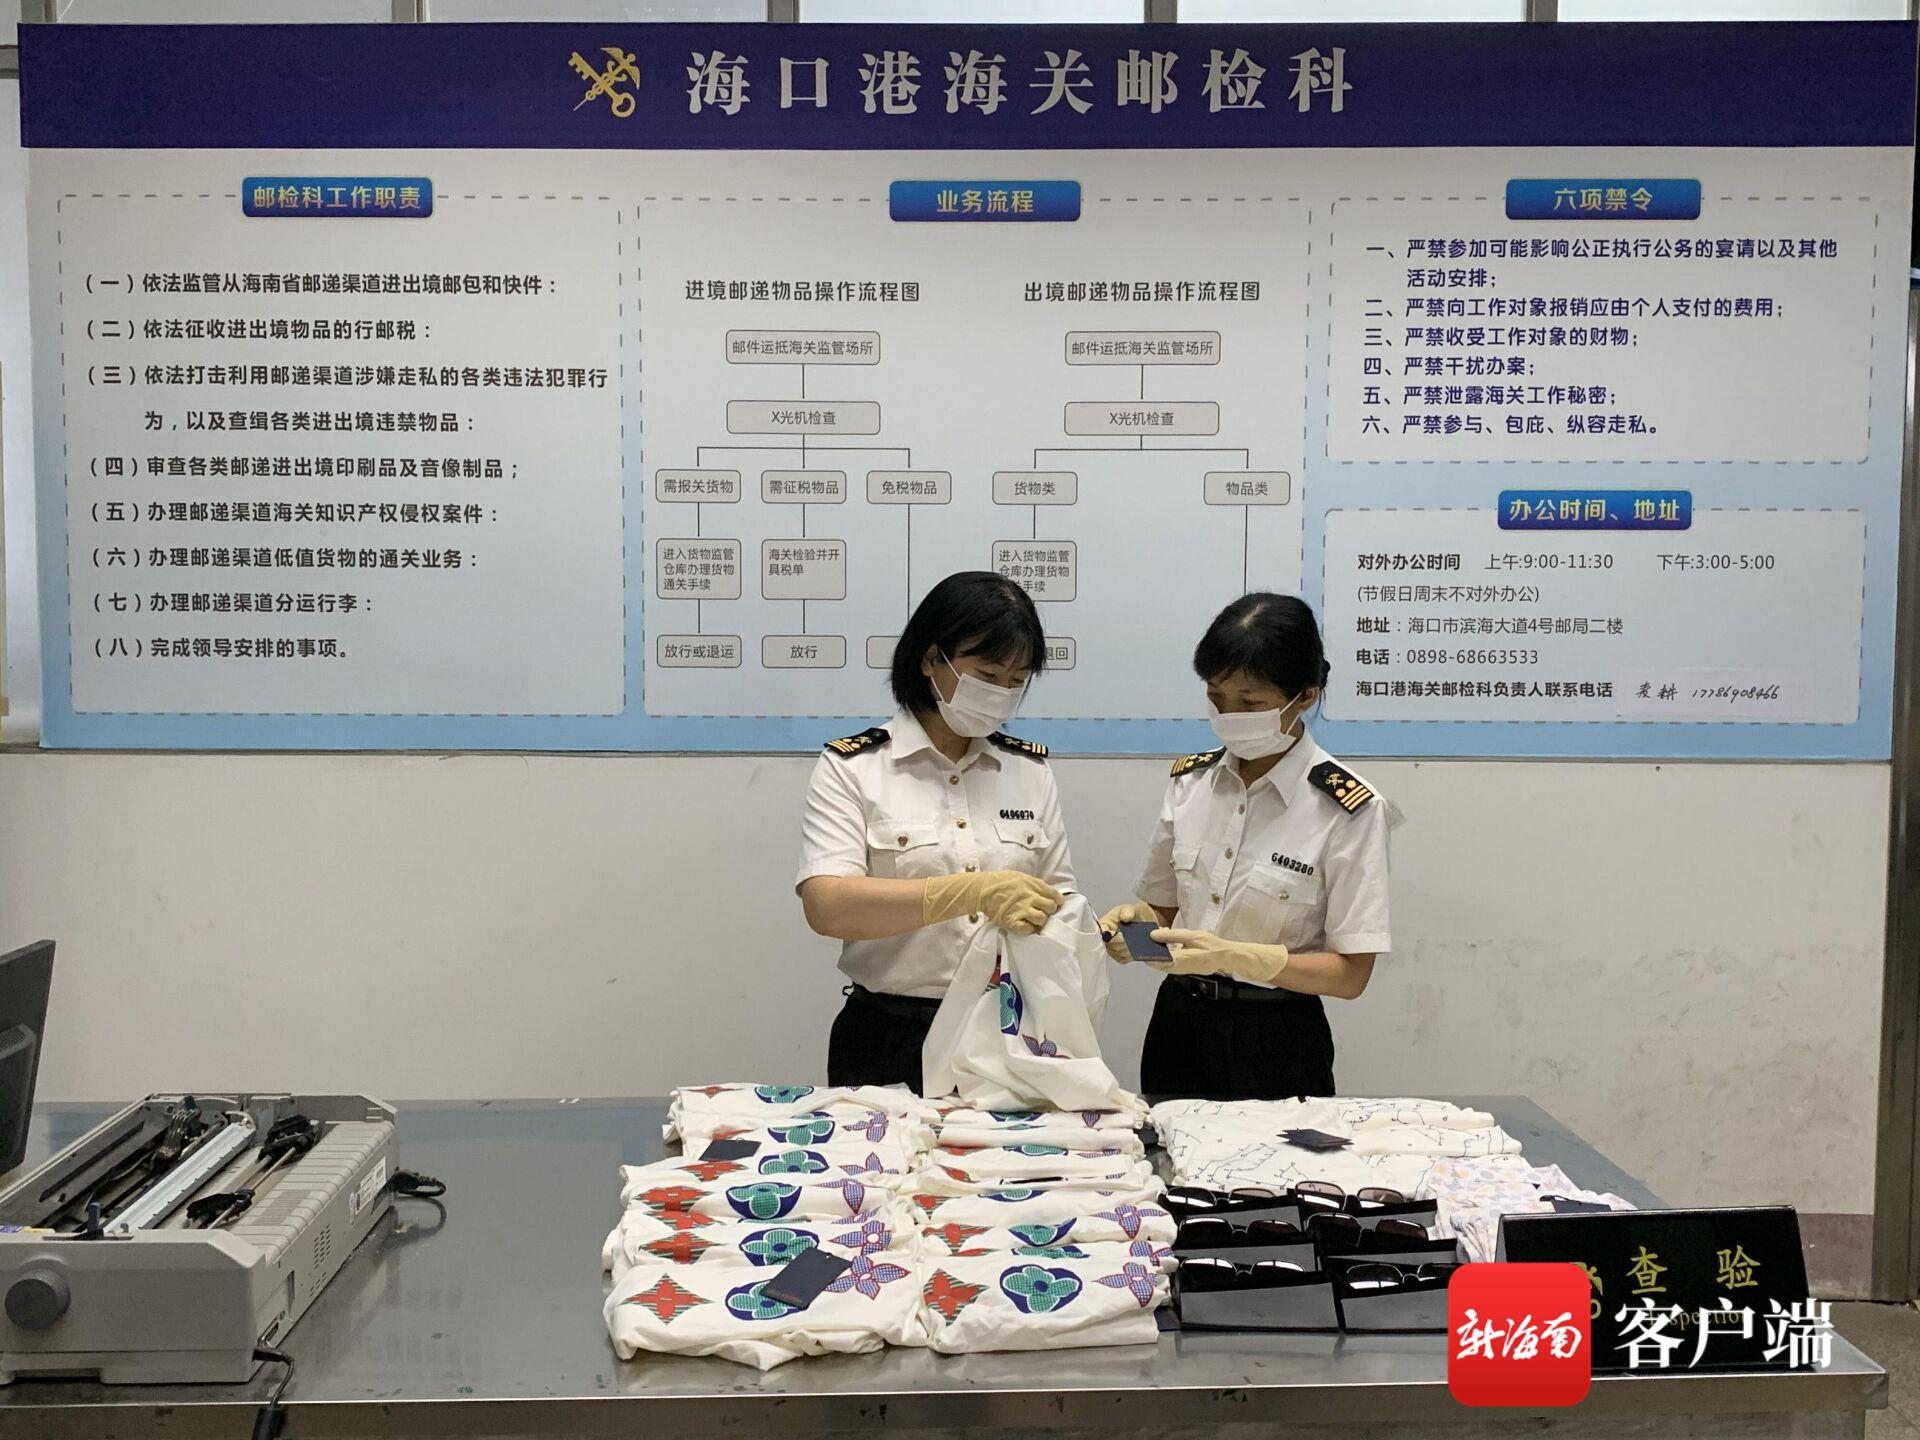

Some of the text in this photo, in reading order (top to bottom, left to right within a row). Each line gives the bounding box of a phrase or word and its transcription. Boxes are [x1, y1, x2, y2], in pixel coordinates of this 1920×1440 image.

[686, 47, 1353, 116] 海口港海关邮检科
[253, 186, 421, 209] 邮检科工作职责
[936, 189, 1034, 214] 业务流程
[1553, 187, 1655, 212] 六项禁令
[1407, 267, 1496, 288] 活动安排；
[685, 279, 920, 303] 进境邮递物品操作流程图
[1024, 281, 1260, 302] 出境邮递物品操作流程图
[732, 339, 874, 356] 邮件运抵海关监管场所
[1071, 340, 1214, 356] 邮件运抵海关监管场所
[1363, 355, 1534, 376] 四、严禁干扰办案；
[771, 410, 836, 425] X光机检查
[1109, 411, 1175, 426] X光机检查
[663, 478, 734, 494] 需报关货物
[768, 479, 839, 495] 需征税物品
[881, 480, 938, 495] 免税物品
[1014, 481, 1056, 496] 货物类
[1225, 481, 1268, 497] 物品类
[1509, 499, 1680, 523] 办公时间、地址
[663, 547, 735, 561] 进入货物监管
[768, 548, 840, 561] 海关检验并开
[998, 549, 1070, 563] 进入货物监管
[1357, 553, 1461, 571] 对外办公时间
[663, 562, 735, 576] 仓库办理货物
[768, 563, 804, 576] 具税单
[999, 564, 1071, 579] 仓库办理货物
[663, 577, 711, 591] 通关手续
[664, 643, 735, 659] 放行或退运
[790, 644, 819, 659] 放行
[1627, 1246, 1760, 1294] 查验
